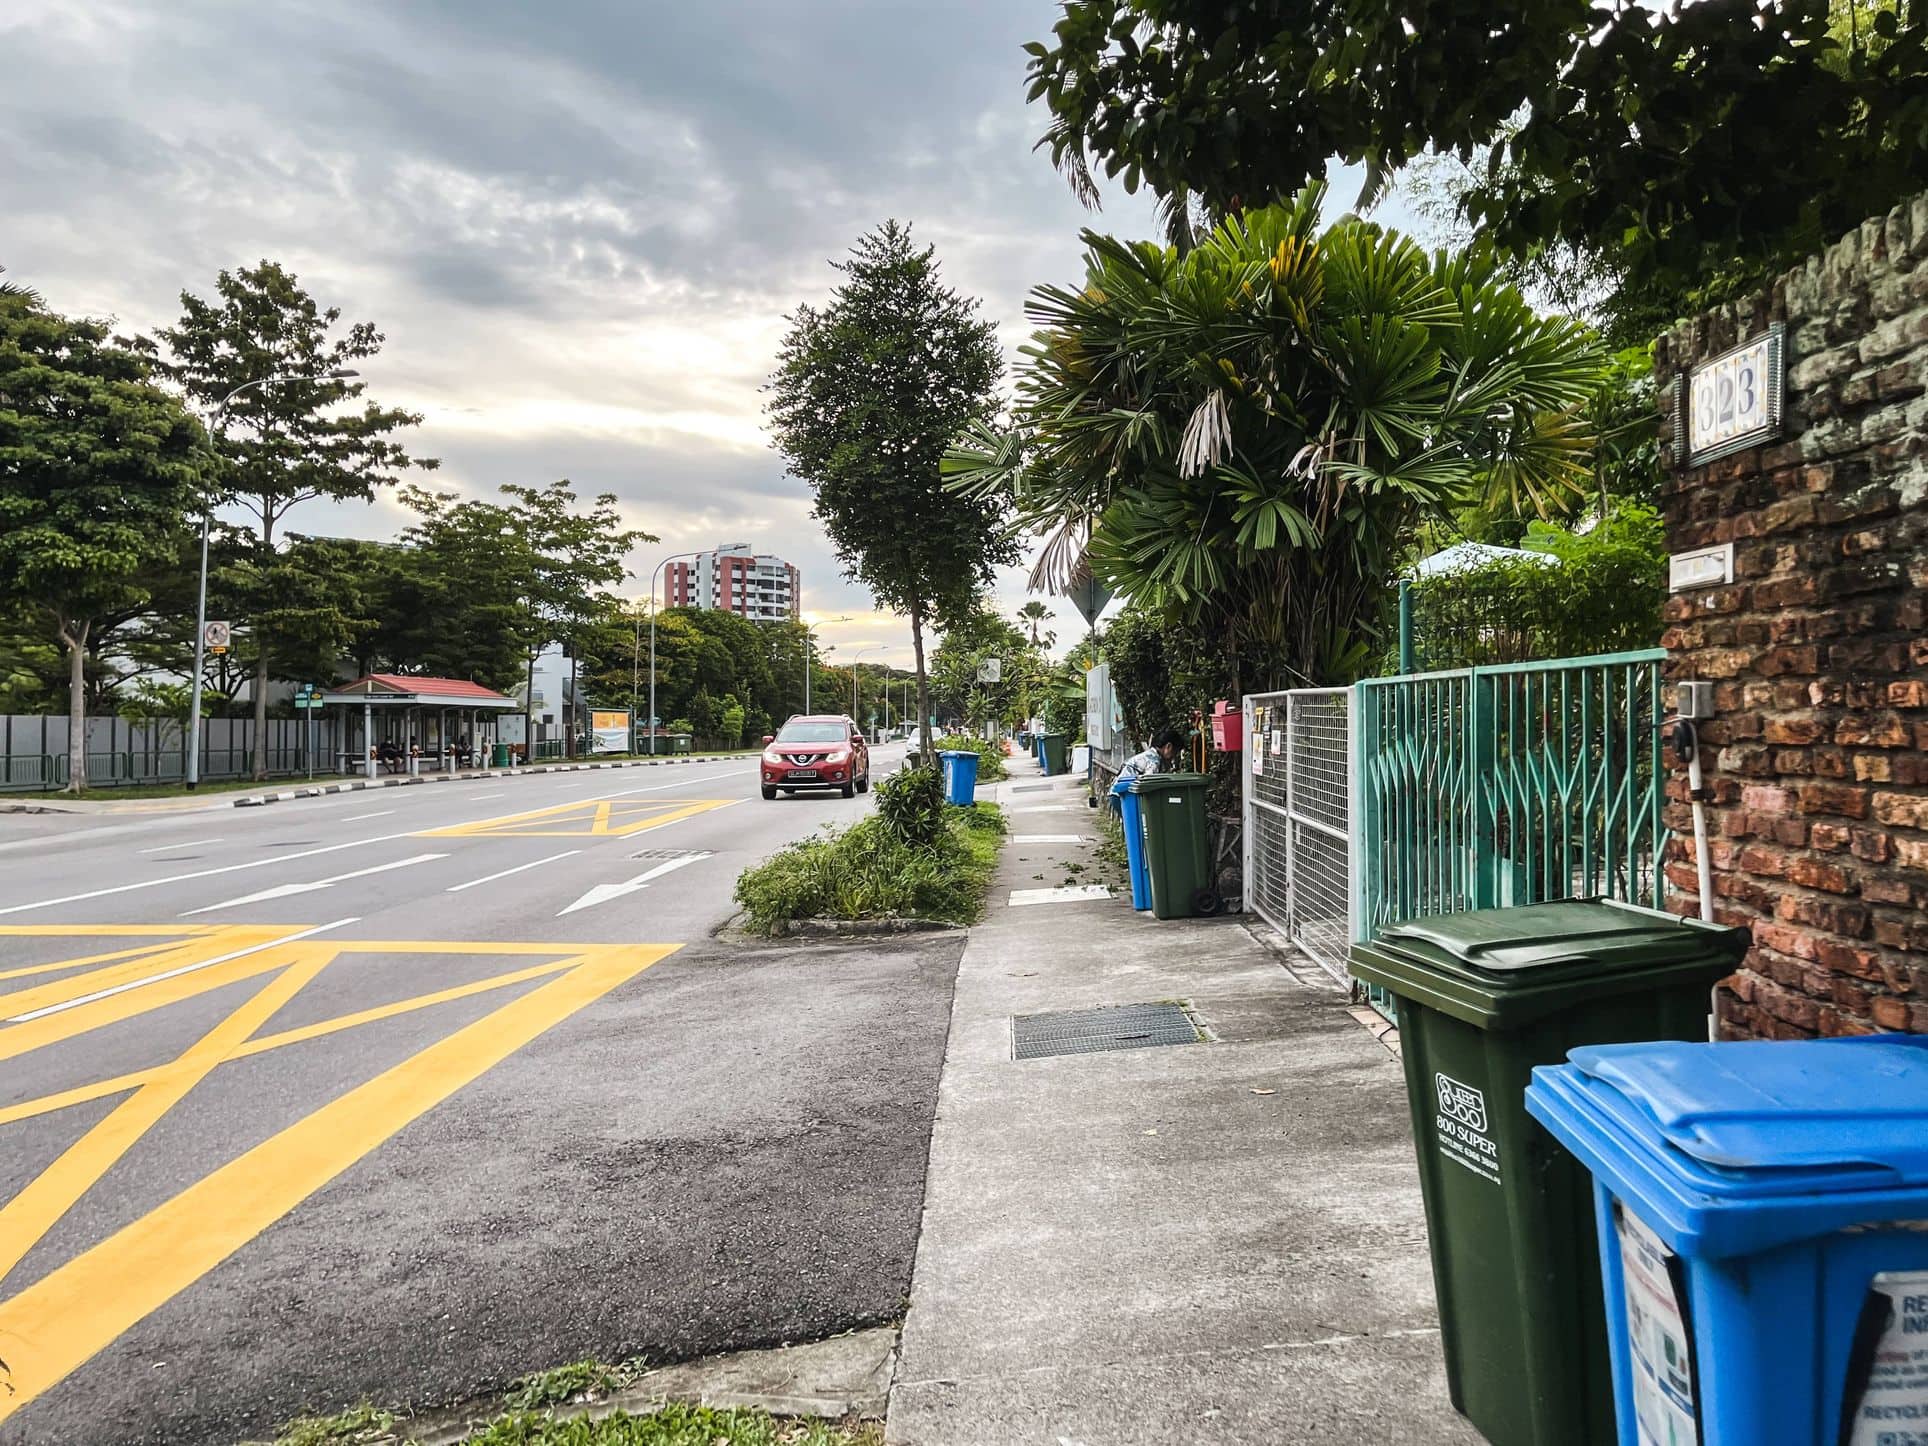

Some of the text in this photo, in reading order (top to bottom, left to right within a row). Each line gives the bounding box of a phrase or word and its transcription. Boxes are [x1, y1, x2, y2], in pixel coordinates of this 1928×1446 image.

[1701, 367, 1754, 432] 323
[1436, 1114, 1497, 1158] 800 SUPER
